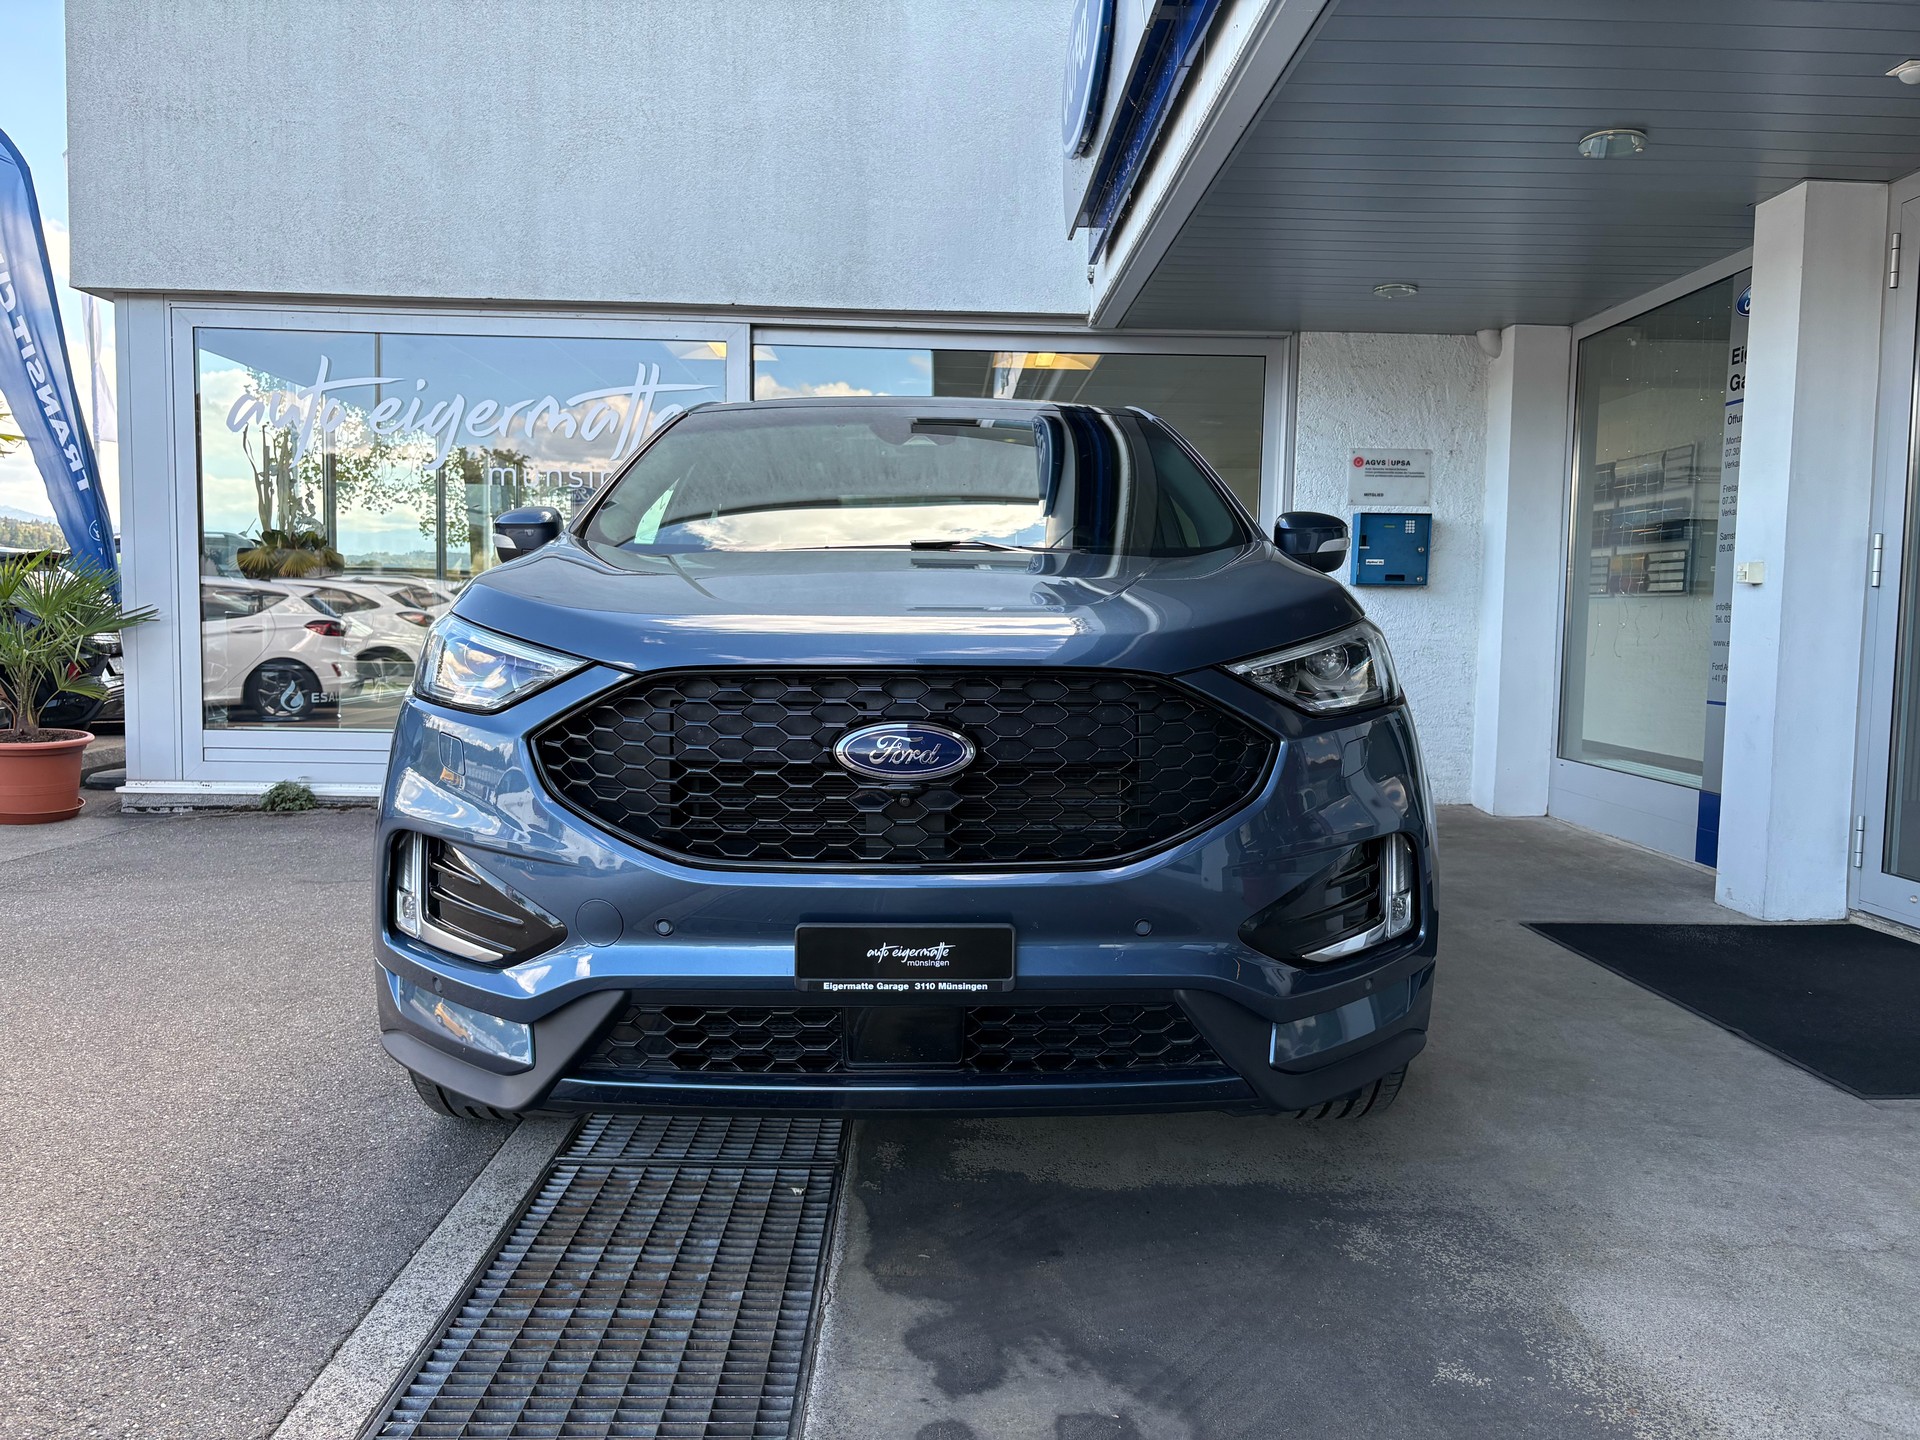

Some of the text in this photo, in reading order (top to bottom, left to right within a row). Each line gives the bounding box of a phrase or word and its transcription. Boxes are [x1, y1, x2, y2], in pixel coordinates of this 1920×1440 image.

[226, 354, 404, 469] auto
[868, 735, 942, 765] Ford
[867, 942, 956, 963] auto eigermatte
[823, 982, 988, 991] Eigermatte Garage 3110 Münsingen
